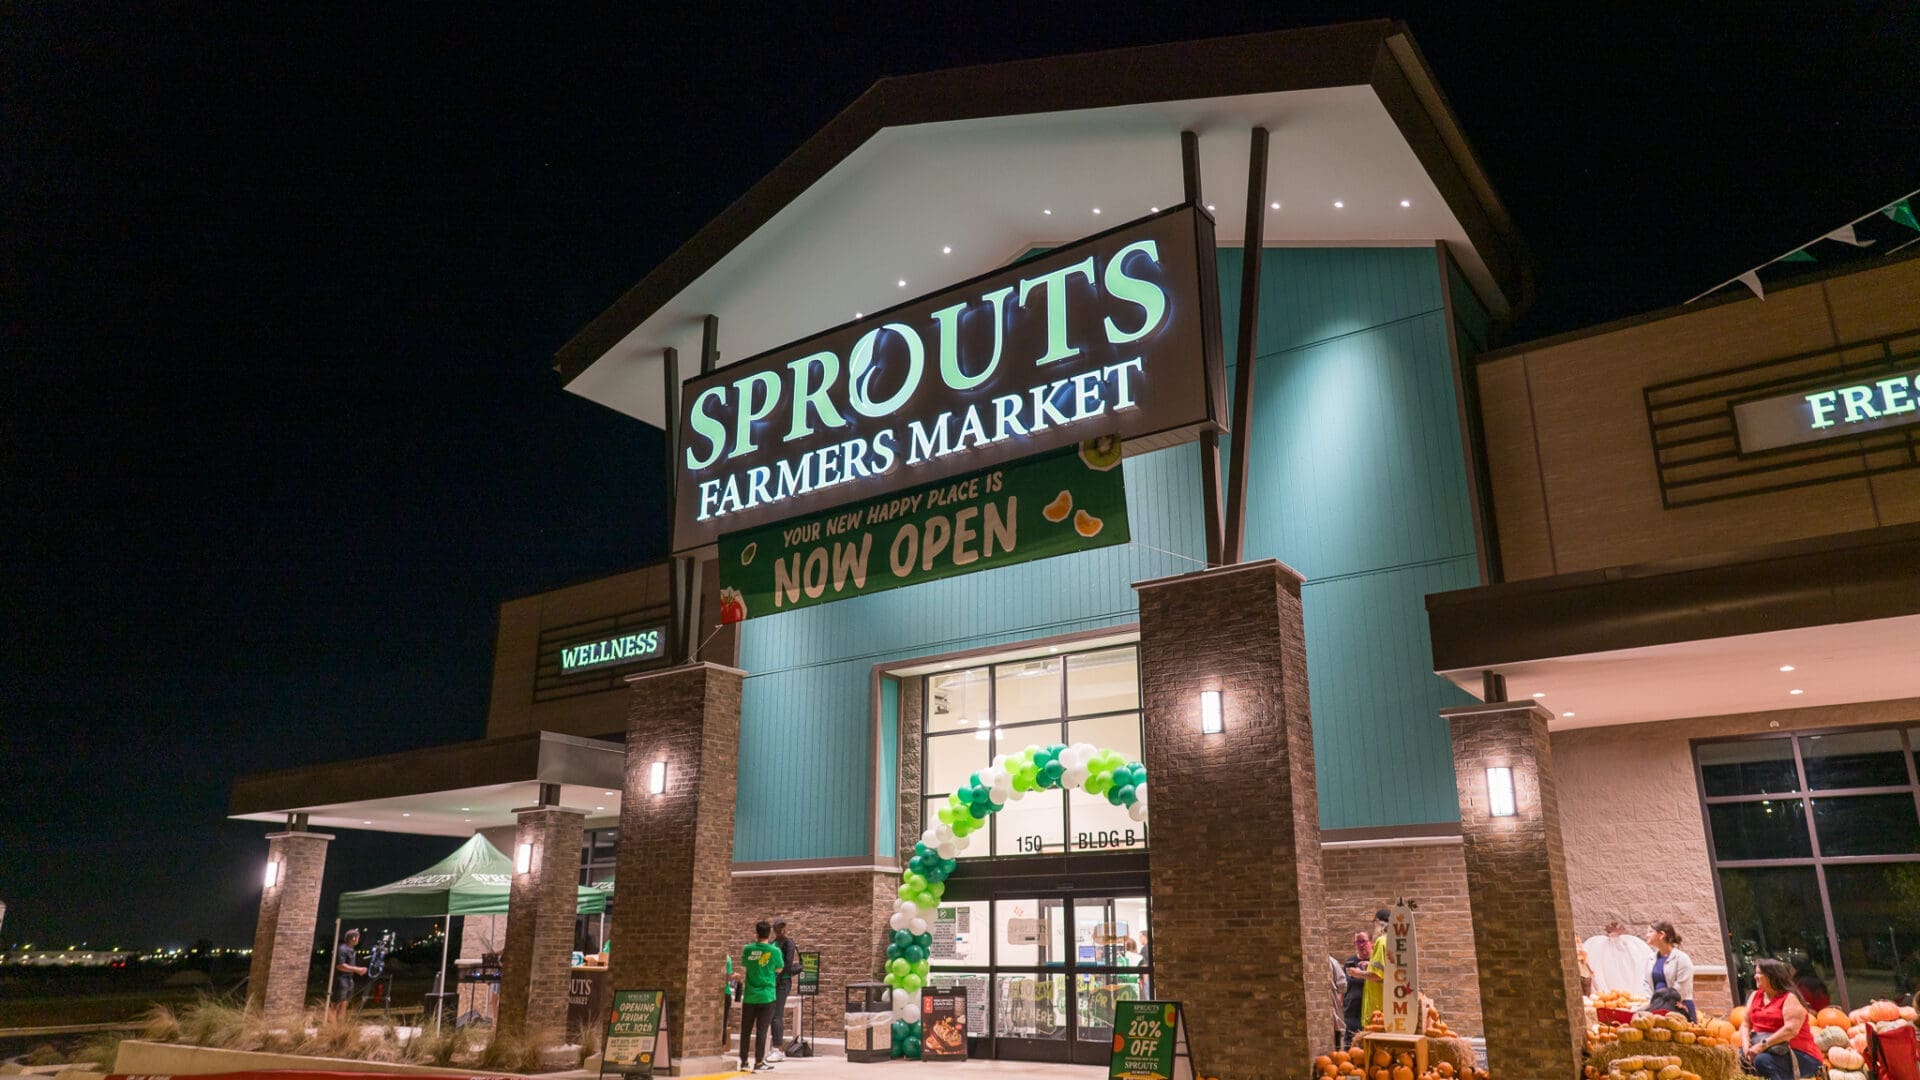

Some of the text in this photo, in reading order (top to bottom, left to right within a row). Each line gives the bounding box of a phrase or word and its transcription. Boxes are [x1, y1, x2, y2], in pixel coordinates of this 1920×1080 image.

[686, 239, 1167, 471] SPROUTS
[1805, 372, 1920, 430] FRE
[697, 356, 1145, 522] FARMERS MARKET
[783, 471, 1003, 548] YOUR NEW HAPPY PLACE IS
[774, 495, 1018, 607] NOW OPEN
[561, 630, 659, 669] WELLNESS
[1016, 835, 1042, 853] 150
[1078, 829, 1136, 849] BLDG B
[1393, 923, 1410, 1032] WELCOME
[619, 1002, 655, 1012] OPENING
[1128, 1020, 1162, 1038] 20%
[1130, 1040, 1158, 1057] OFF
[1124, 1061, 1158, 1070] SPROUTS
